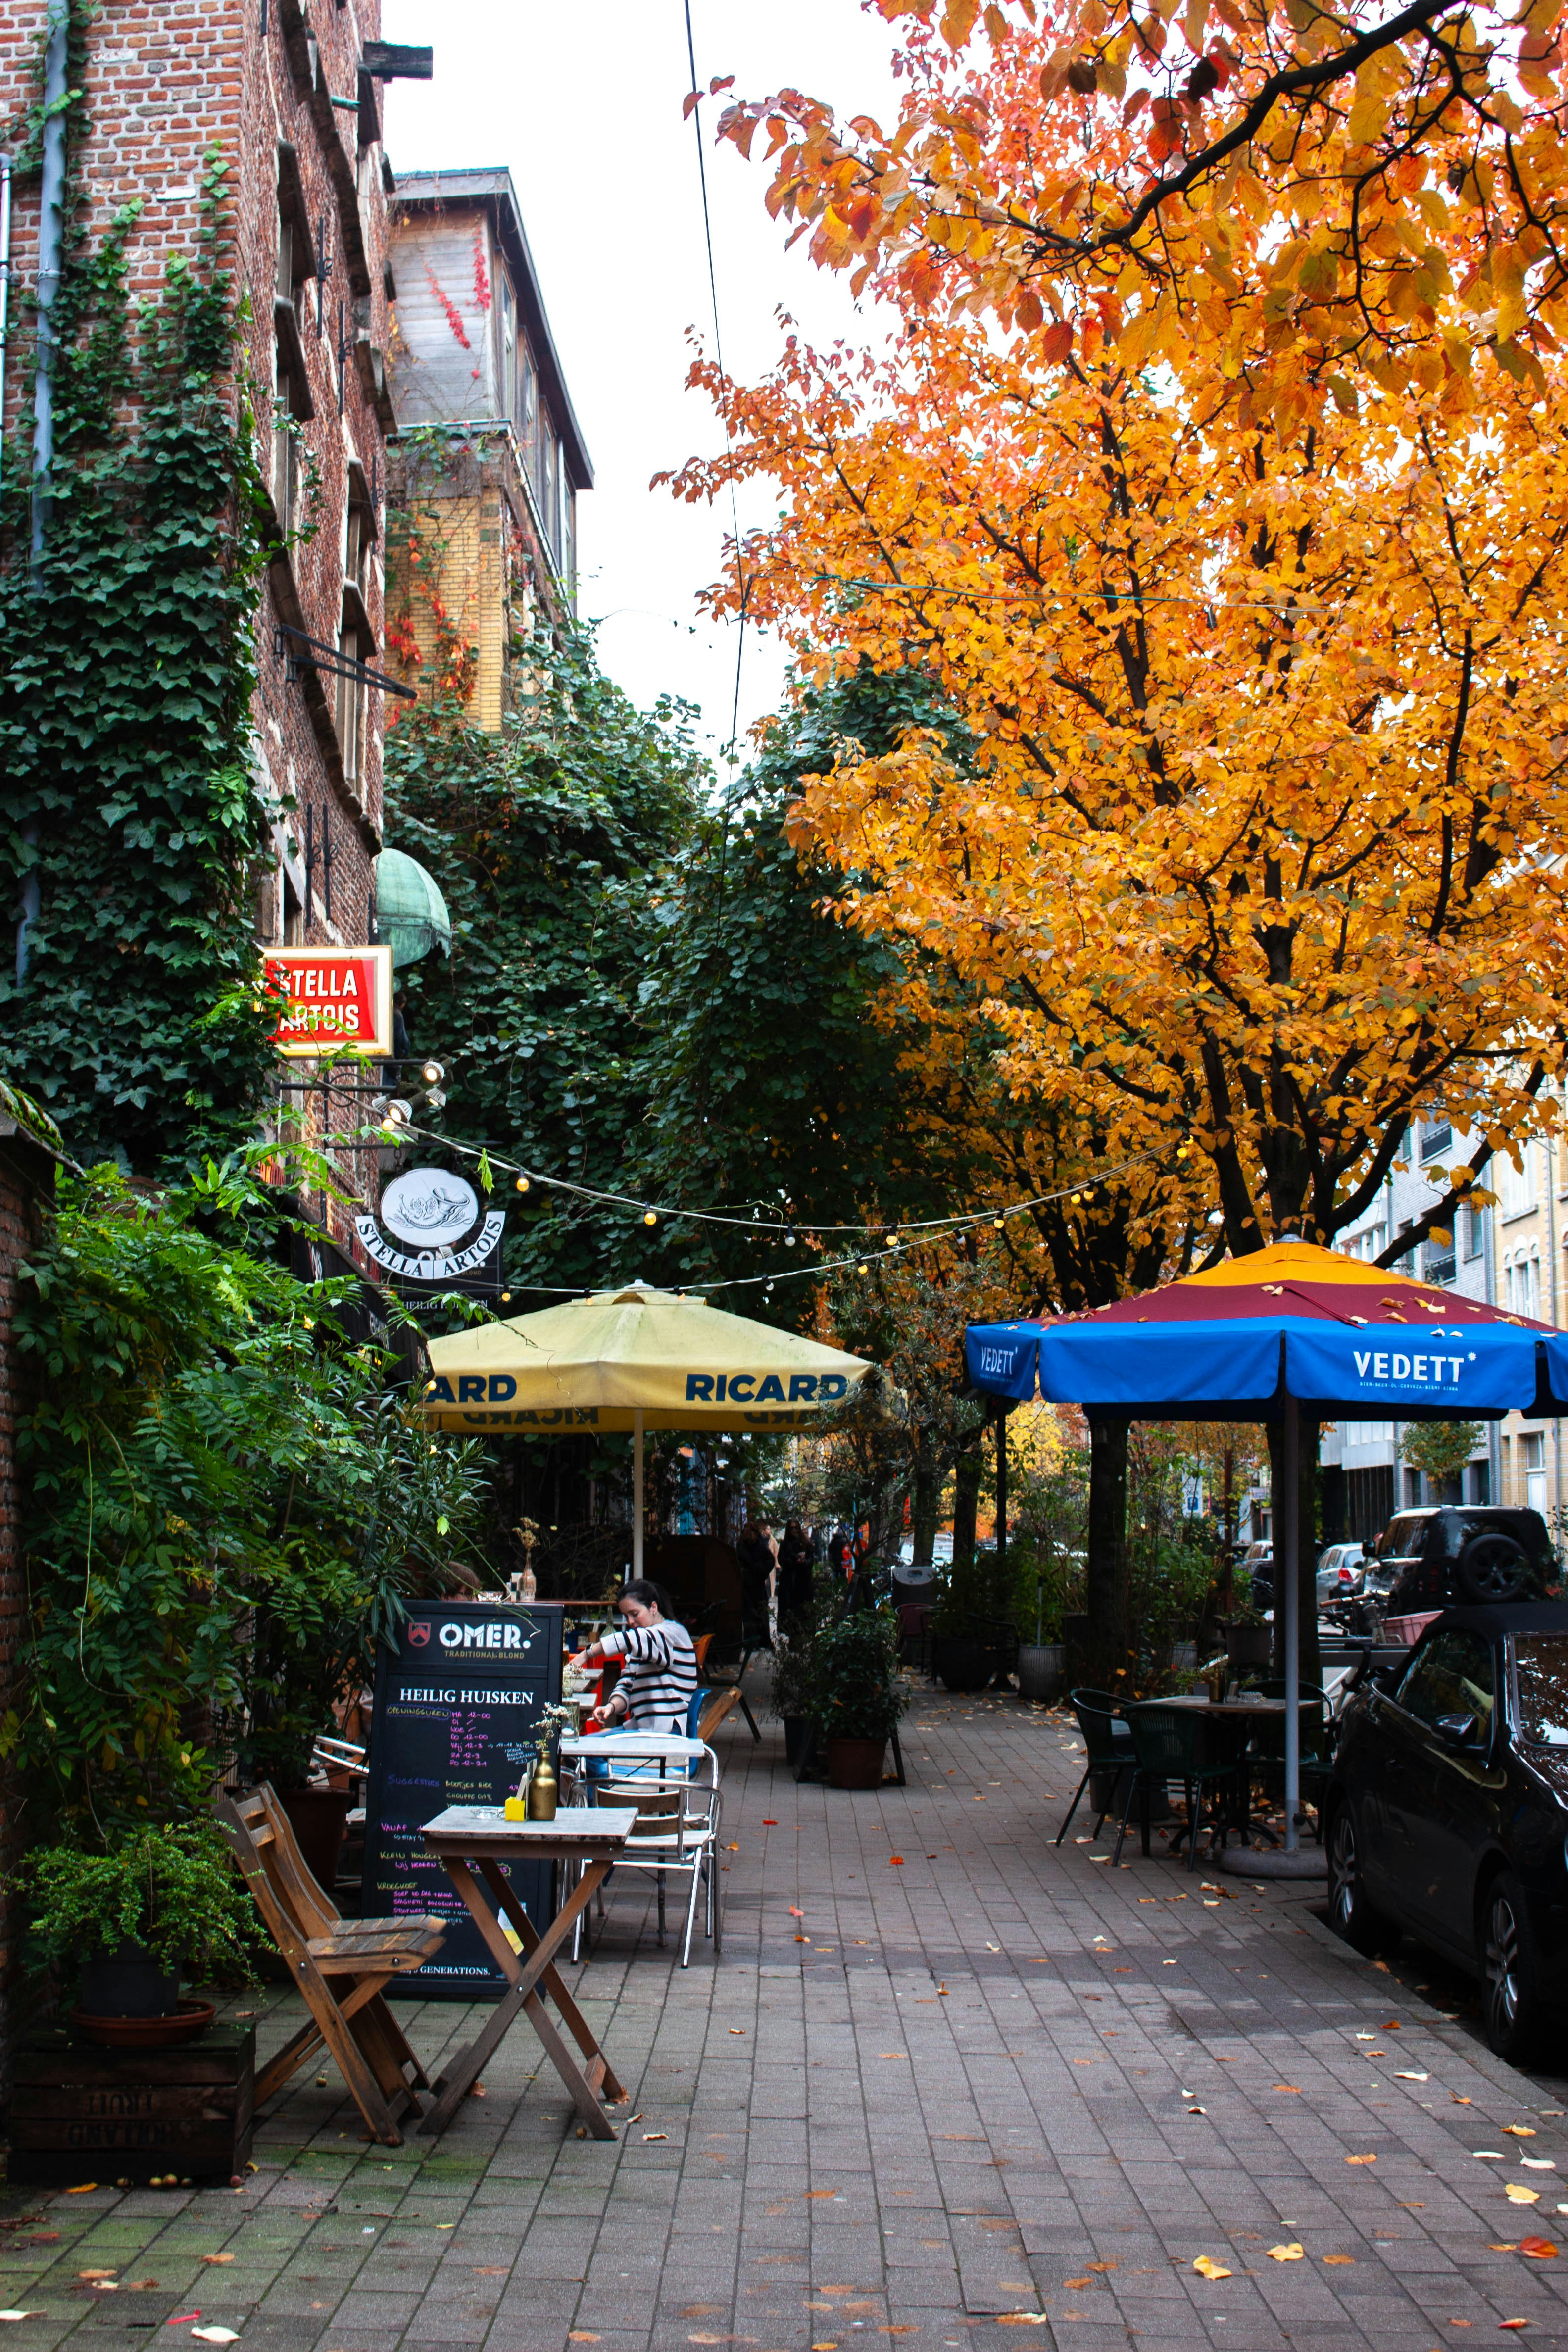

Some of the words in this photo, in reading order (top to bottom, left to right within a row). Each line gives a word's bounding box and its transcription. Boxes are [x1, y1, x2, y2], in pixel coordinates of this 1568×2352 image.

[280, 970, 357, 997] STELLA
[280, 1005, 359, 1031] ARTOIS
[359, 1223, 423, 1276] STELLA
[444, 1219, 501, 1275] ARTOIS
[981, 1346, 1014, 1375] VEDETT
[1353, 1351, 1464, 1382] VEDETT
[422, 1374, 517, 1403] ARD
[686, 1374, 848, 1402] RICARD
[444, 1650, 496, 1659] TRADITIONAL
[399, 1688, 455, 1703] HEILIG
[460, 1690, 534, 1705] HUISKEN
[387, 1707, 449, 1717] OPENINGSUREN
[381, 1822, 407, 1833] VANAF
[380, 1851, 405, 1860] KLEIN
[420, 1965, 490, 1976] GENERATIONS.
[86, 2093, 152, 2115] FRUIT
